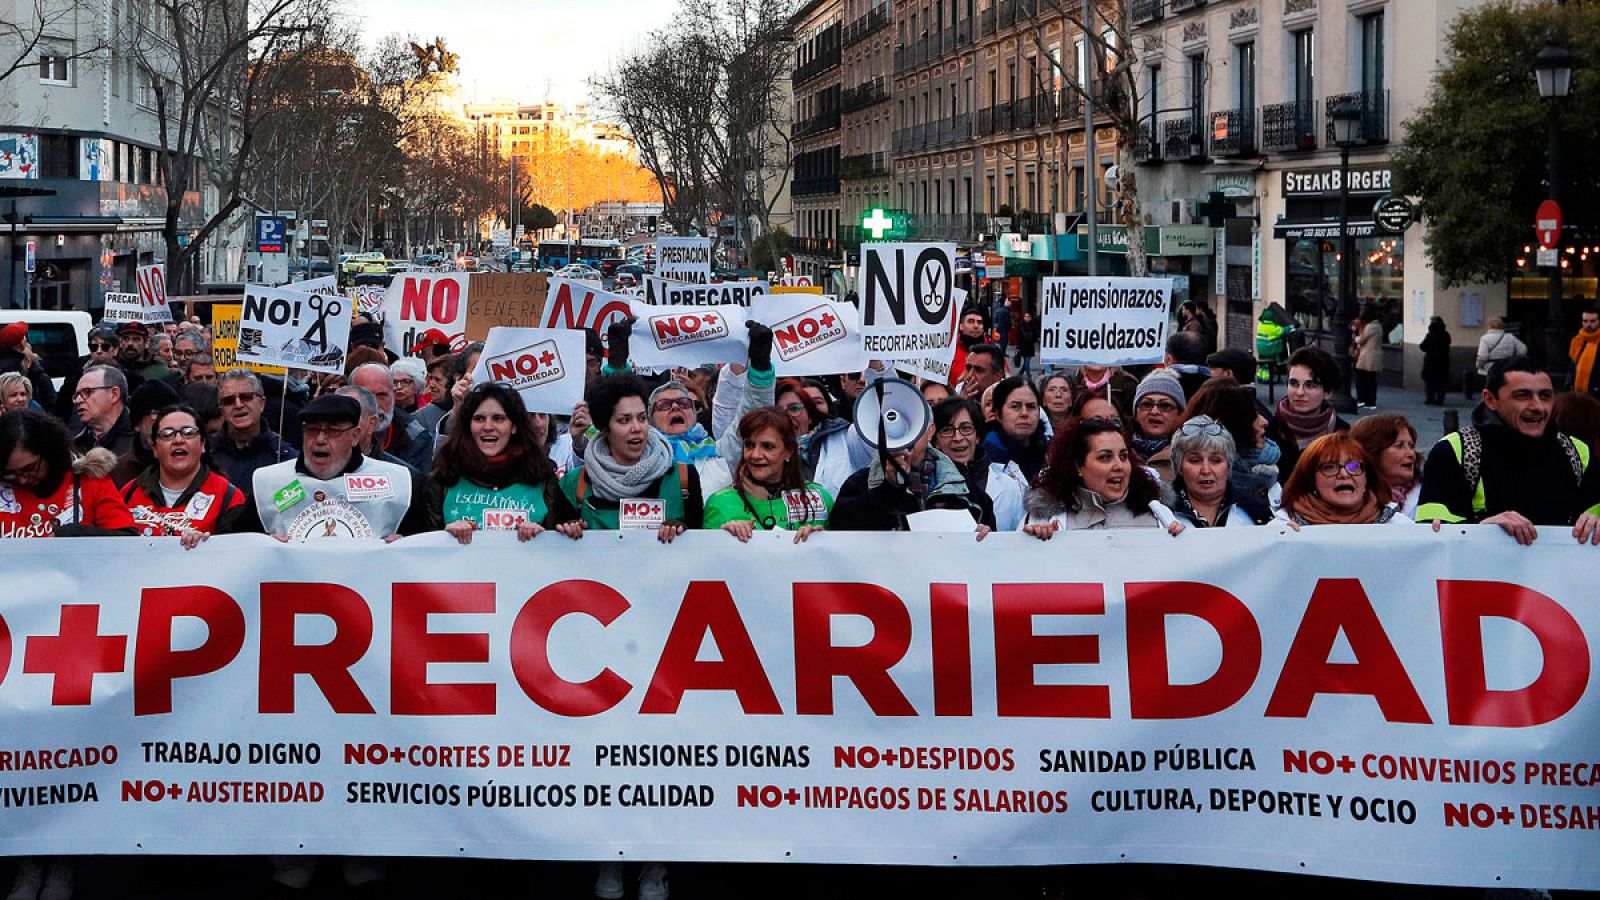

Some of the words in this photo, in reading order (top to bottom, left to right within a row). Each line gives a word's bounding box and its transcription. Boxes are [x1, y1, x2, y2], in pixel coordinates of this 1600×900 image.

[261, 220, 276, 239] P
[137, 267, 165, 307] NO
[864, 247, 952, 325] NO
[1044, 282, 1066, 315] ¡Ni
[1069, 282, 1166, 315] pensionazos,
[244, 295, 301, 326] NO!
[400, 277, 460, 324] NO
[655, 315, 718, 340] NO+
[660, 326, 724, 345] PRECARIEDAD
[775, 312, 836, 349] NO+
[783, 327, 841, 356] PRECARIEDAD
[1043, 322, 1060, 348] ni
[1065, 321, 1164, 350] sueldazos!
[864, 335, 918, 352] RECORTAR
[492, 350, 555, 381] NO+
[624, 503, 661, 516] NO+
[142, 742, 242, 765] TRABAJO
[249, 742, 321, 765] DIGNO
[498, 745, 525, 768] DE
[532, 744, 571, 768] LUZ
[596, 744, 718, 767] PENSIONES
[726, 745, 810, 768] DIGNAS
[1040, 749, 1147, 773] SANIDAD
[1154, 743, 1257, 772] PÚBLICA
[1525, 762, 1600, 788] PRECA
[0, 781, 99, 808] IVIENDA
[346, 781, 461, 807] SERVICIOS
[468, 780, 577, 808] PÚBLICOS
[584, 785, 612, 807] DE
[619, 784, 714, 807] CALIDAD
[918, 788, 947, 811] DE
[954, 788, 1069, 814] SALARIOS
[1091, 788, 1203, 814] CULTURA,
[1210, 788, 1322, 817] DEPORTE
[1327, 795, 1344, 819] Y
[1350, 797, 1417, 825] OCIO
